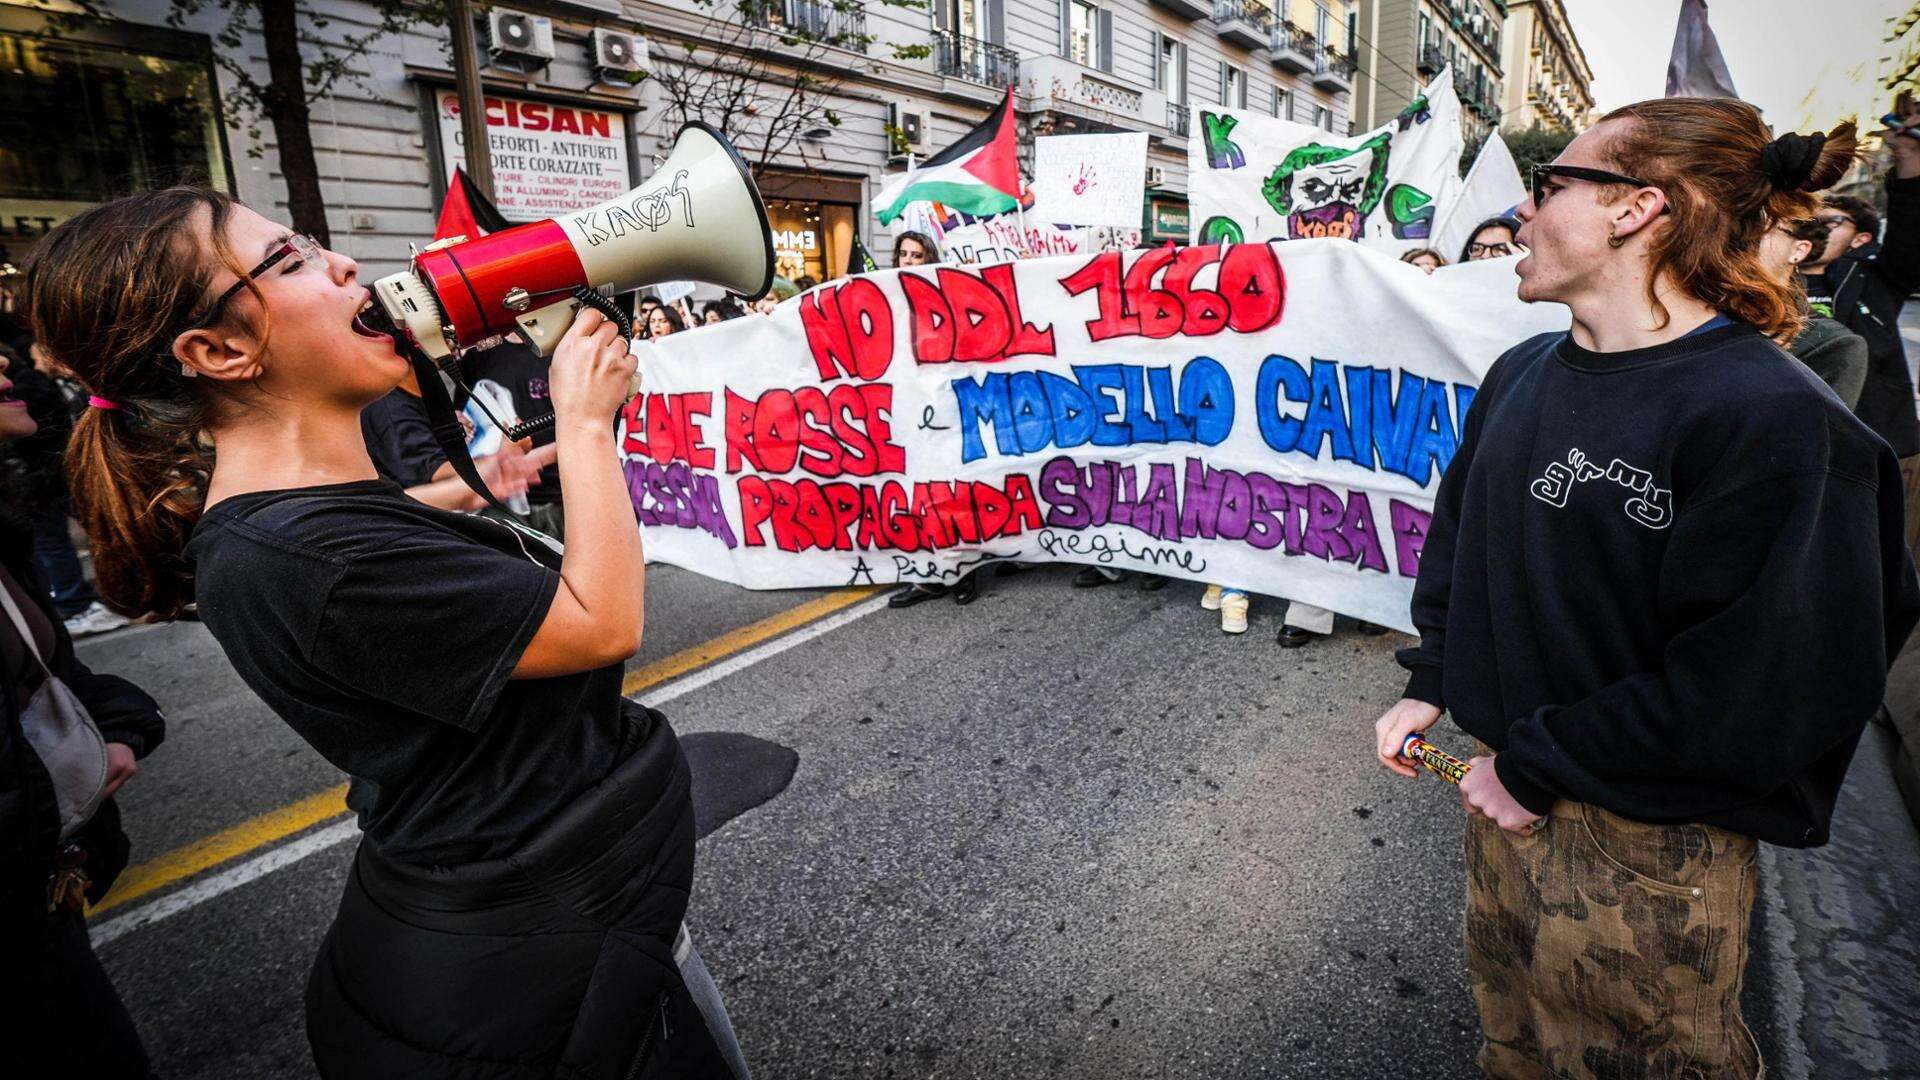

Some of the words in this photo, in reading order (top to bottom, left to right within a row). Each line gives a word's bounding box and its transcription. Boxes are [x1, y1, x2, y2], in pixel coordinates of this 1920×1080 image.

[485, 98, 609, 138] CISAN
[489, 153, 527, 171] ORTE
[529, 157, 603, 176] CORAZZATE
[551, 141, 618, 160] ANTIFURTI
[538, 176, 577, 187] CILINDRI
[799, 277, 894, 381] NO
[899, 264, 1055, 365] DDL
[1058, 242, 1287, 343] 1660
[725, 384, 906, 479] ROSSE
[917, 405, 951, 431] e
[951, 356, 1235, 465] MODELLO
[737, 474, 1046, 552] PROPAGANDA
[846, 556, 875, 586] A
[1037, 531, 1207, 574] Regime
